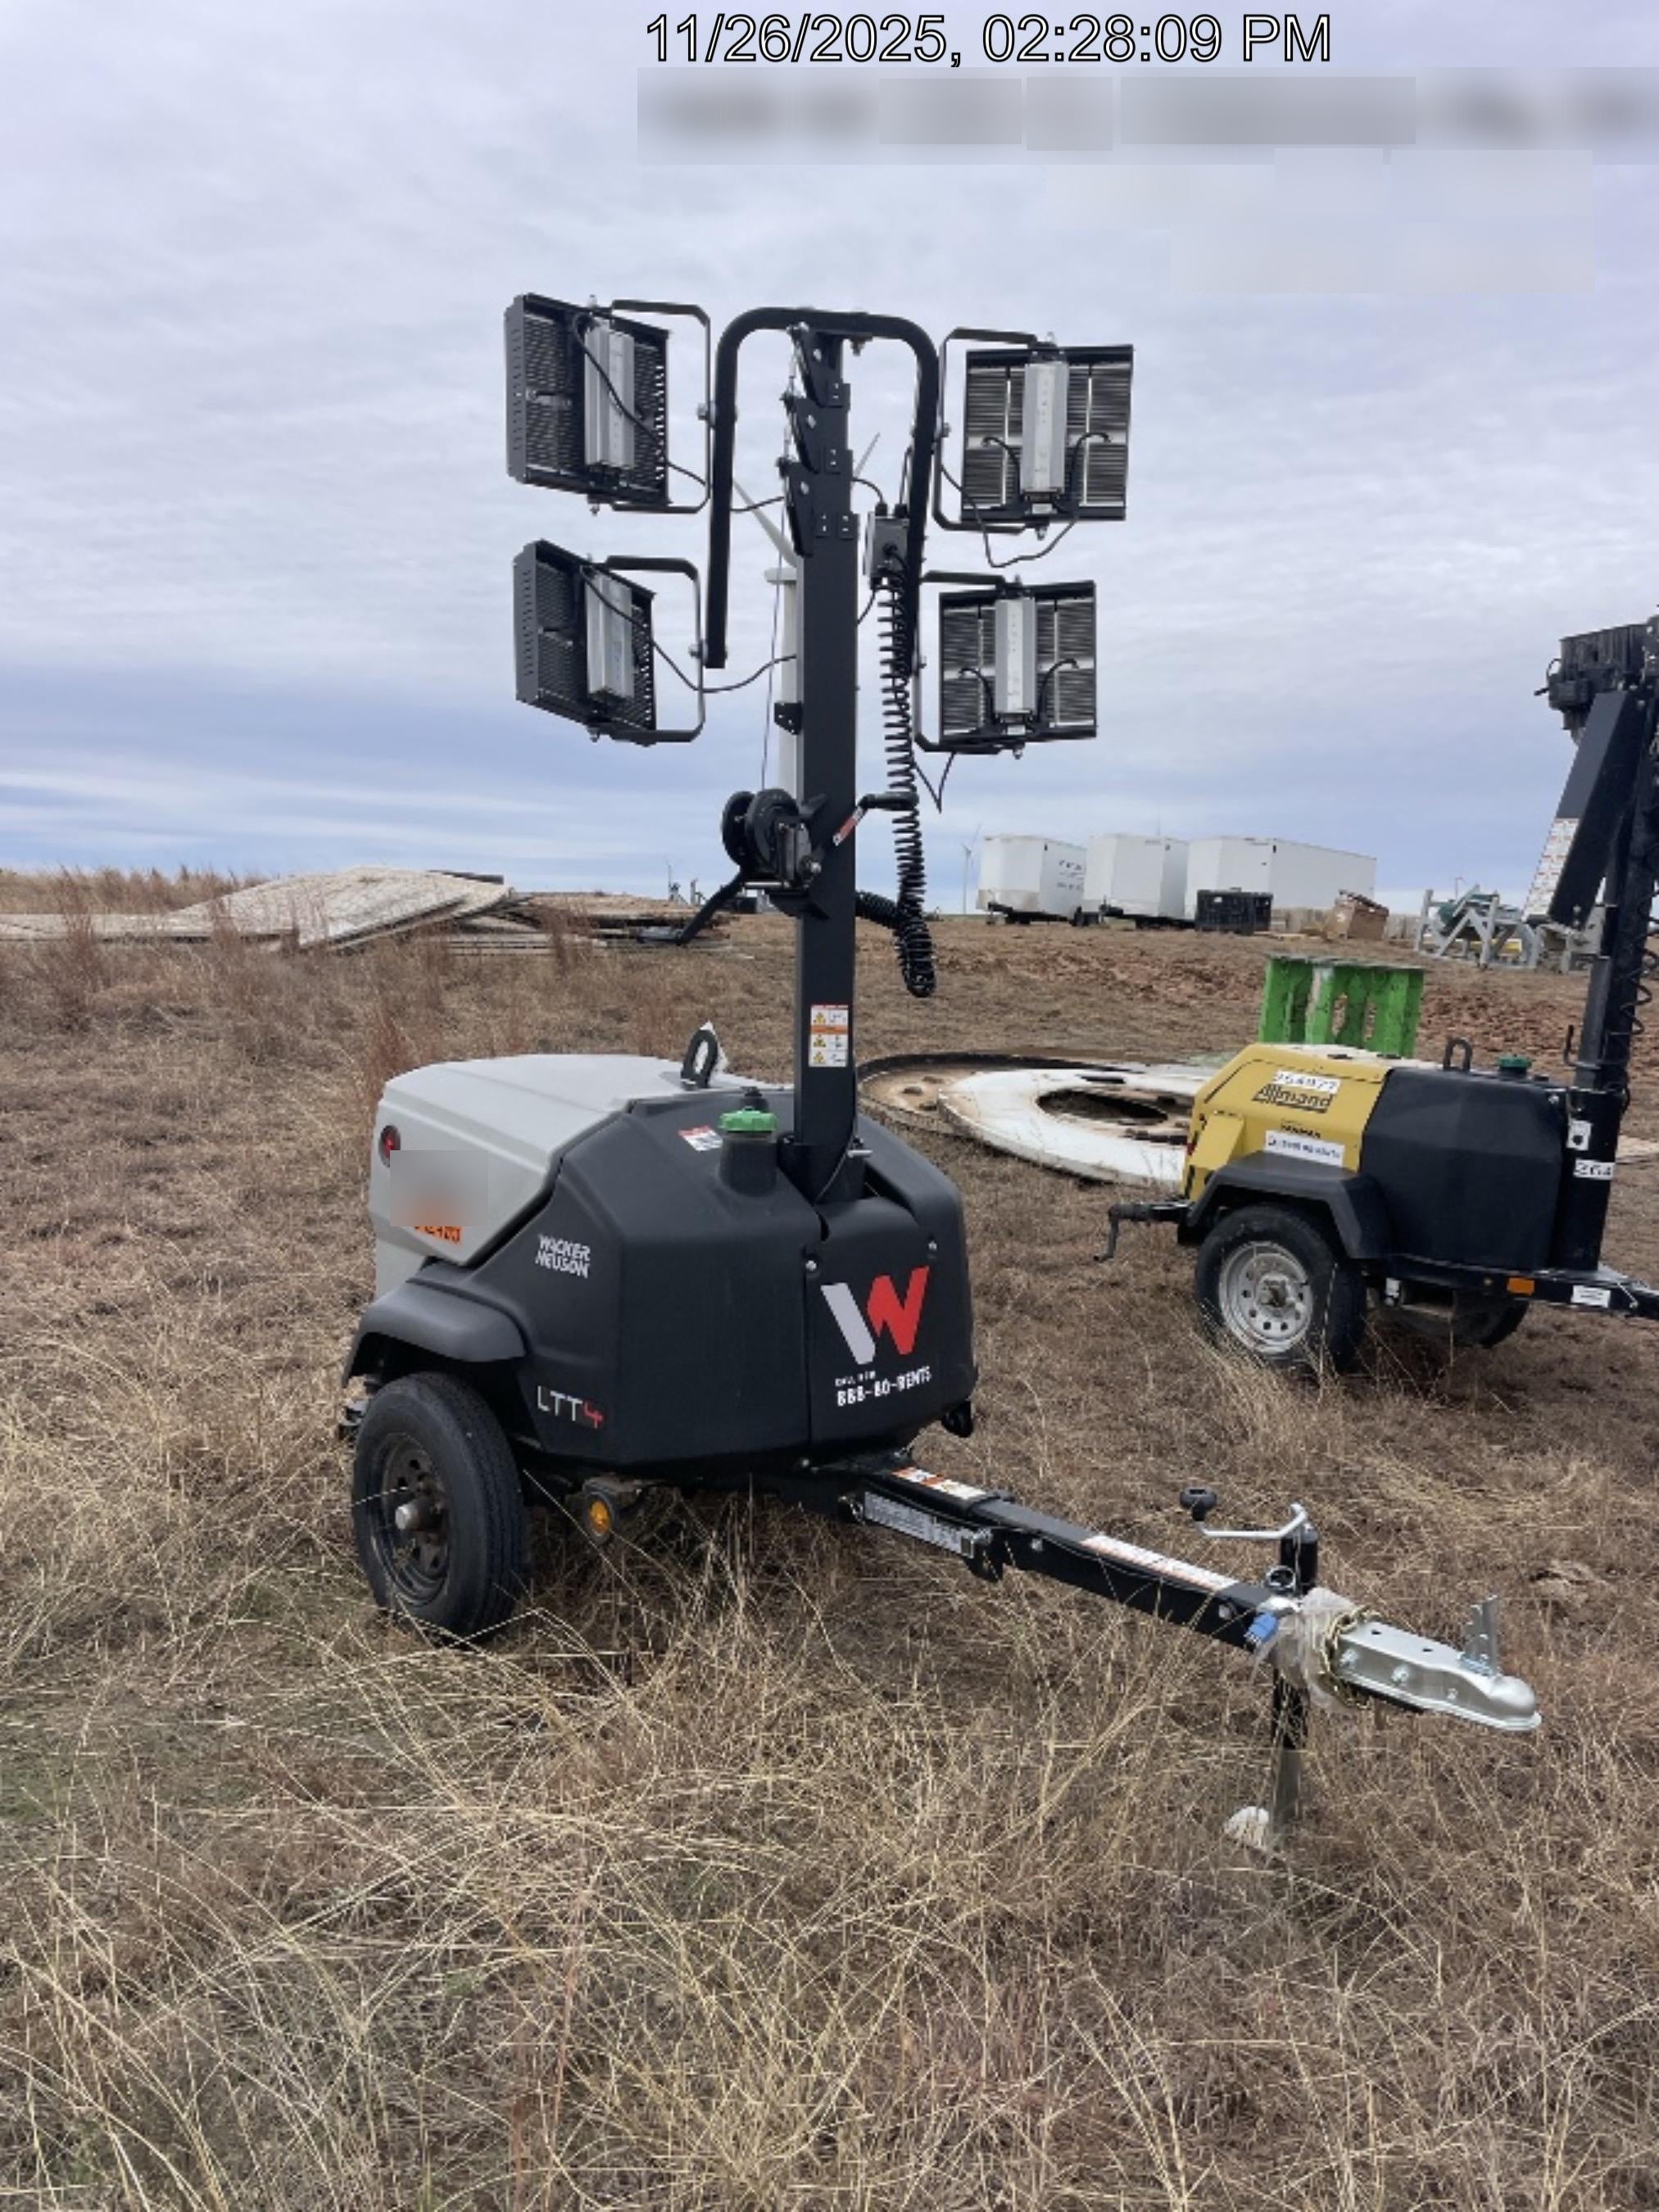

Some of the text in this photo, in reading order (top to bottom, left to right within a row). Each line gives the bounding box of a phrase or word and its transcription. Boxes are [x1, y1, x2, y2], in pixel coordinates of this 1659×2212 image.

[537, 1233, 591, 1262] WACKER
[534, 1250, 591, 1279] NEUSON
[537, 1385, 603, 1430] LTT4
